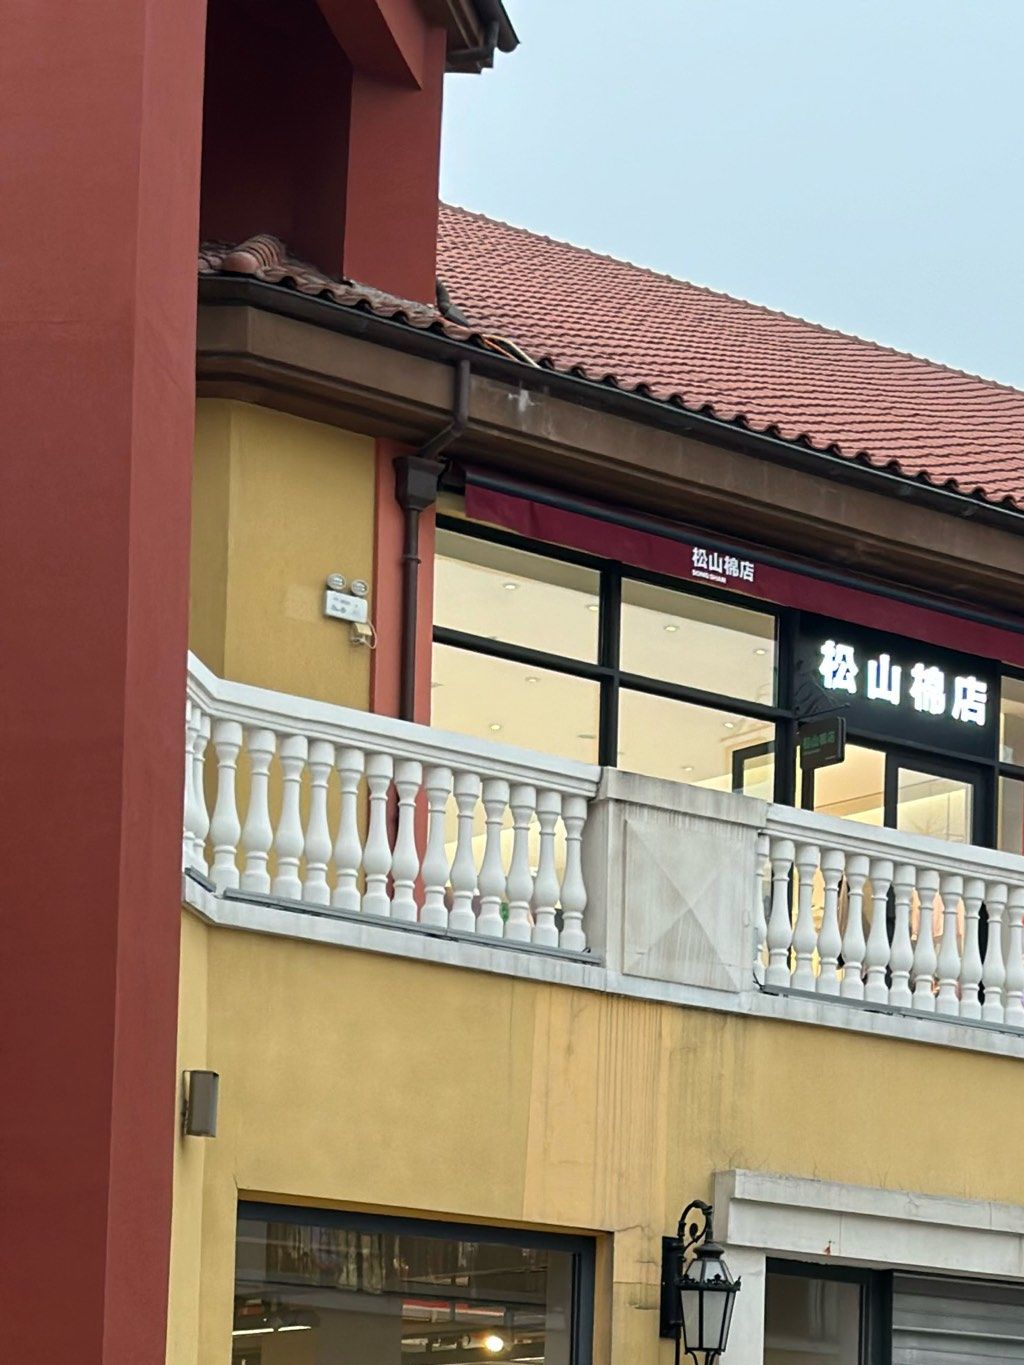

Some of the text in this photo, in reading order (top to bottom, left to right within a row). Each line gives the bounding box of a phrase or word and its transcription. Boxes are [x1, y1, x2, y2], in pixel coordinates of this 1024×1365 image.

[692, 547, 755, 582] 松山棉店
[818, 639, 988, 726] 松山棉店
